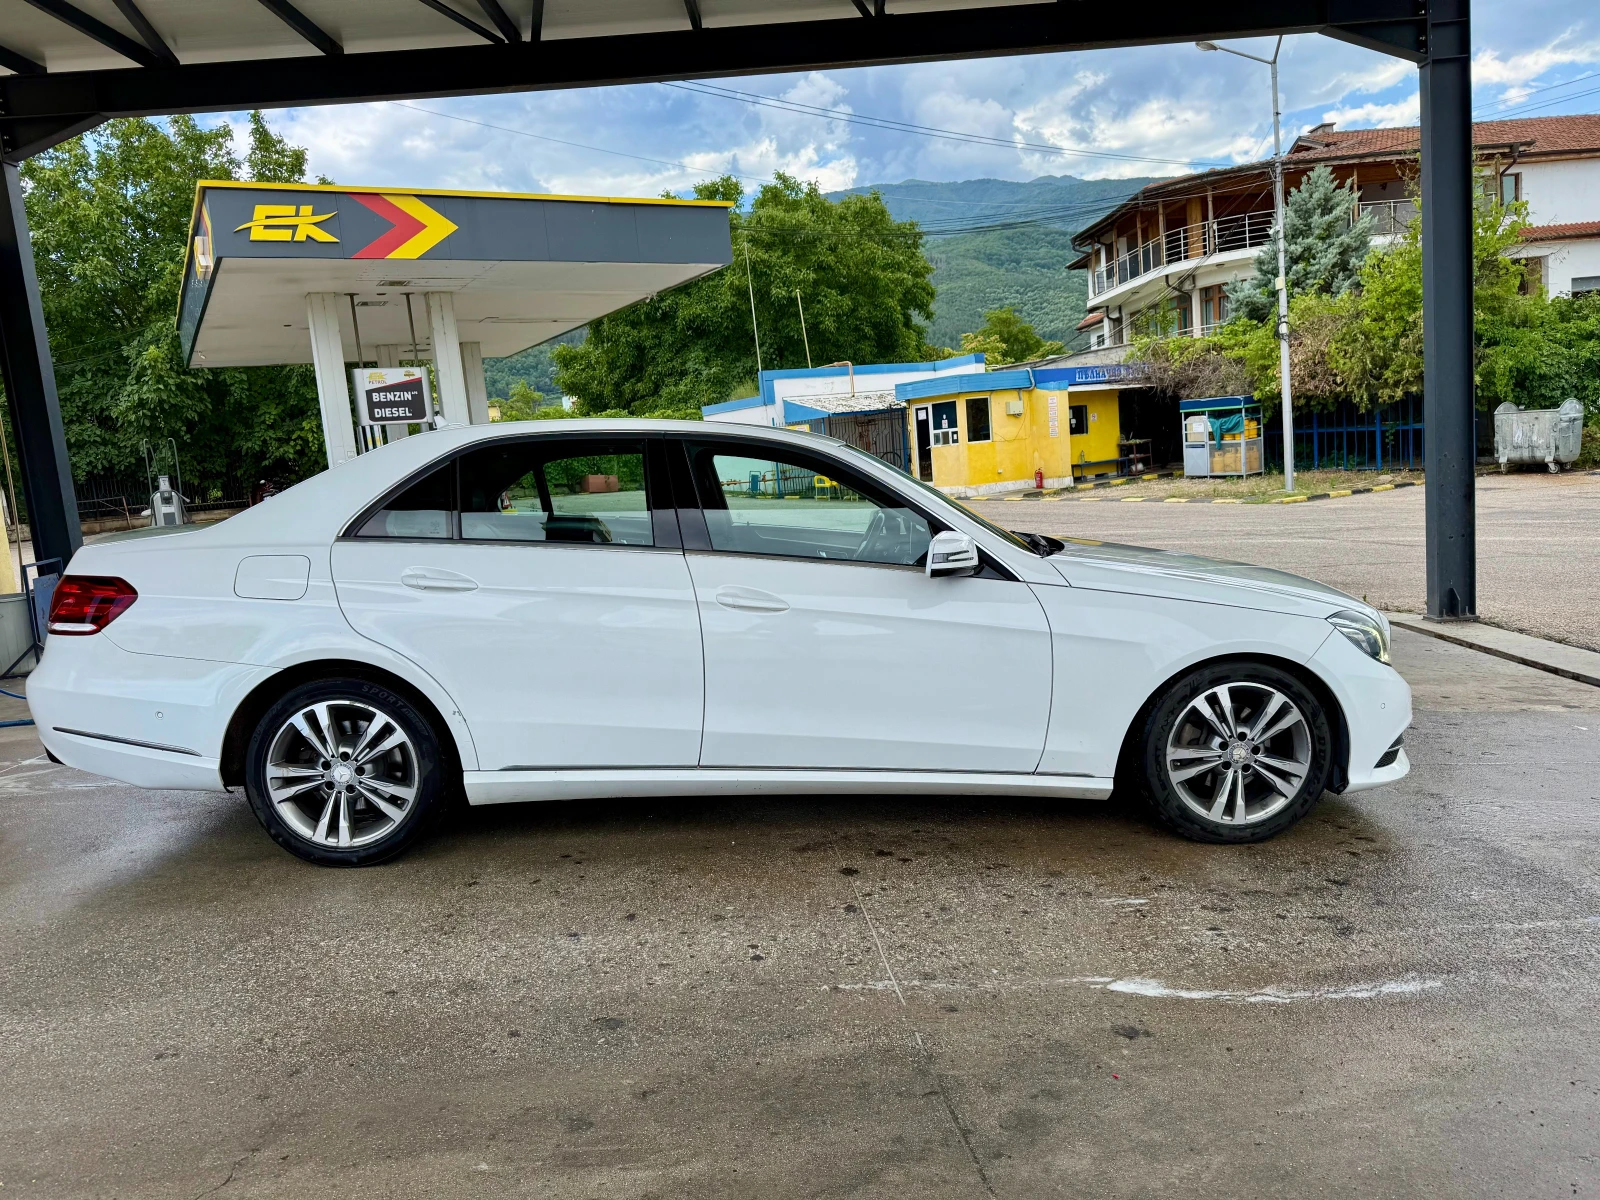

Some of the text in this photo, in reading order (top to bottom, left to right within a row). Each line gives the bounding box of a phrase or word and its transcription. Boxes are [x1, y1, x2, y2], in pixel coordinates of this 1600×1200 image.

[234, 204, 341, 243] EK
[372, 391, 412, 402] BENZIN
[374, 408, 412, 418] DIESEL
[361, 684, 405, 709] SPORT
